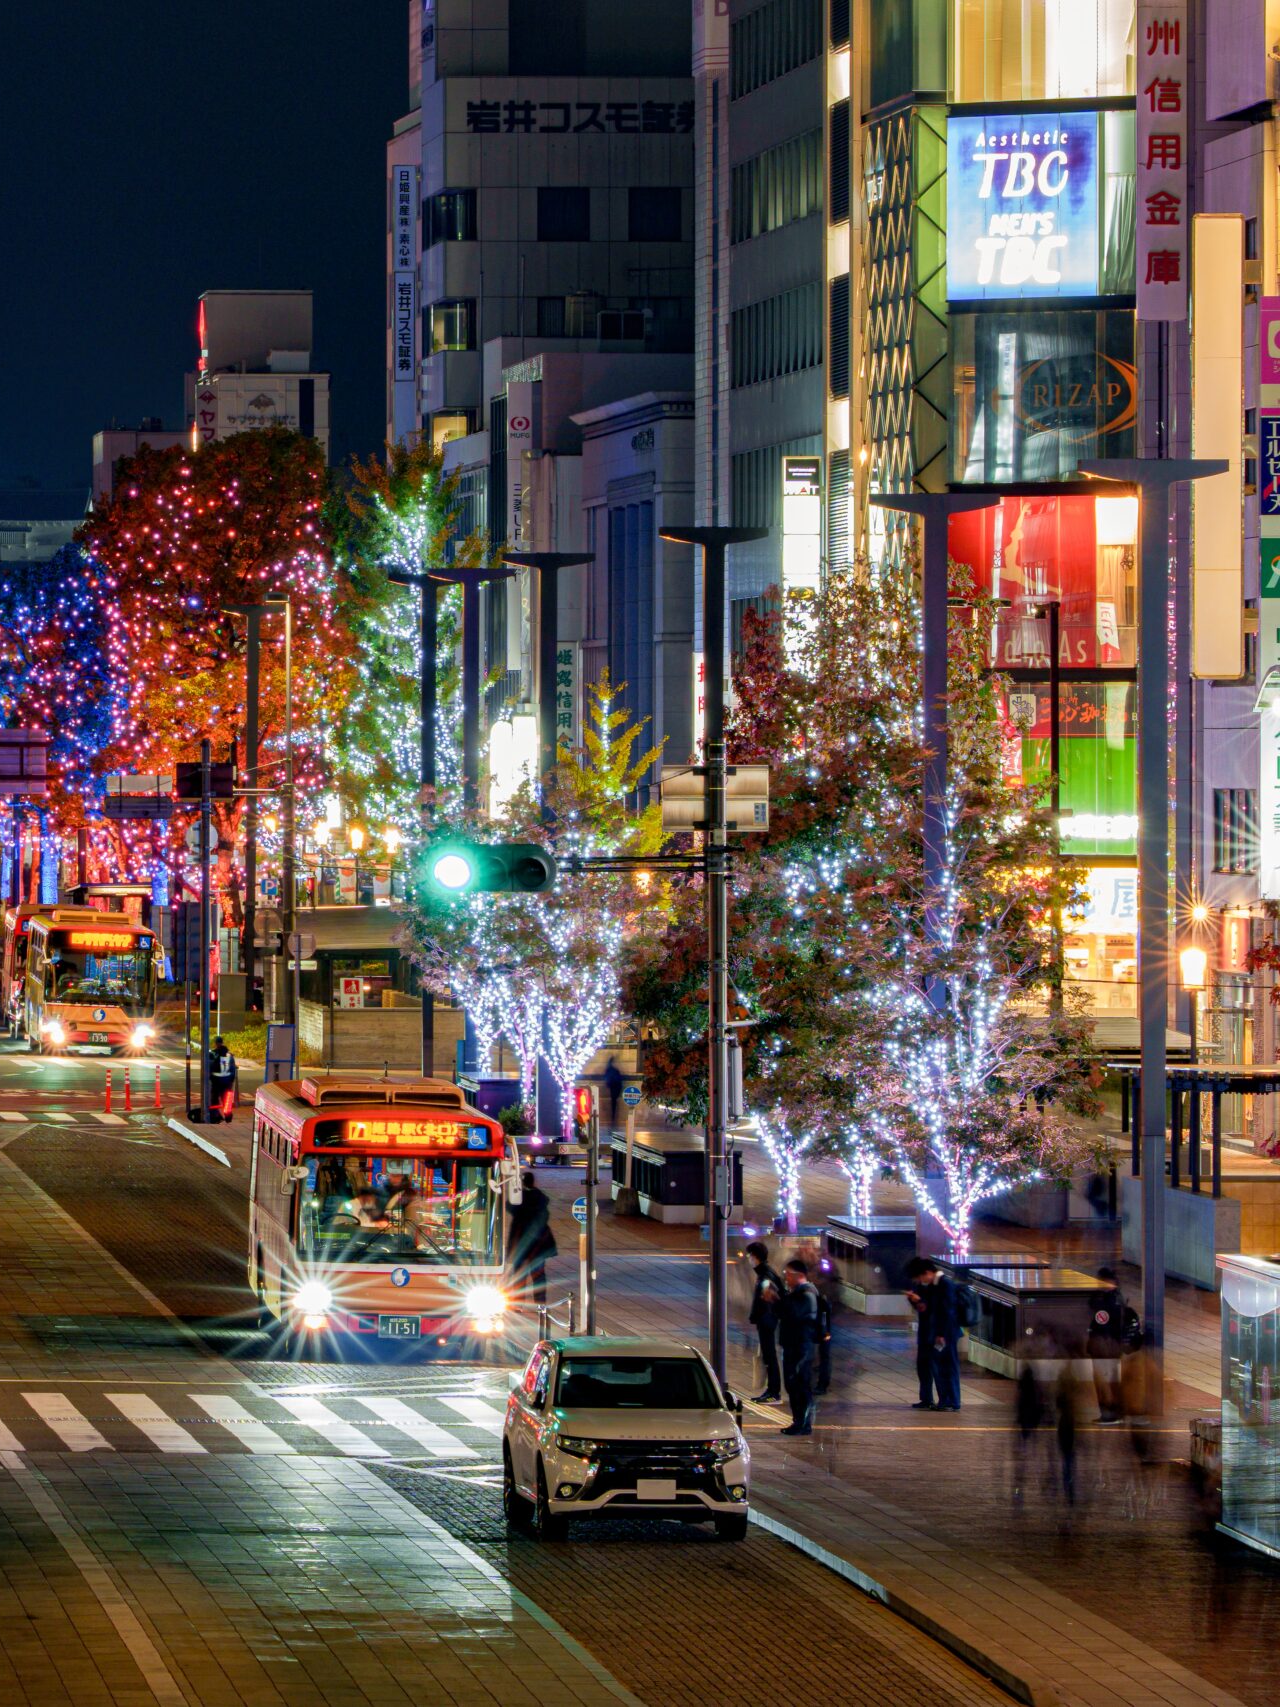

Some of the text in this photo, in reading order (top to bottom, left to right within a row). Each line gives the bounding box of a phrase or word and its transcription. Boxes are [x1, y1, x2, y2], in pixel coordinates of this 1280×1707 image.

[975, 129, 1068, 147] Aesthetic
[1144, 19, 1182, 286] 州信用金庫
[973, 150, 1068, 198] TBC
[975, 235, 1067, 285] TBC
[397, 282, 412, 372] 岩井コスモ証券
[1033, 383, 1122, 407] RIZAP
[388, 1323, 415, 1335] 11-51
